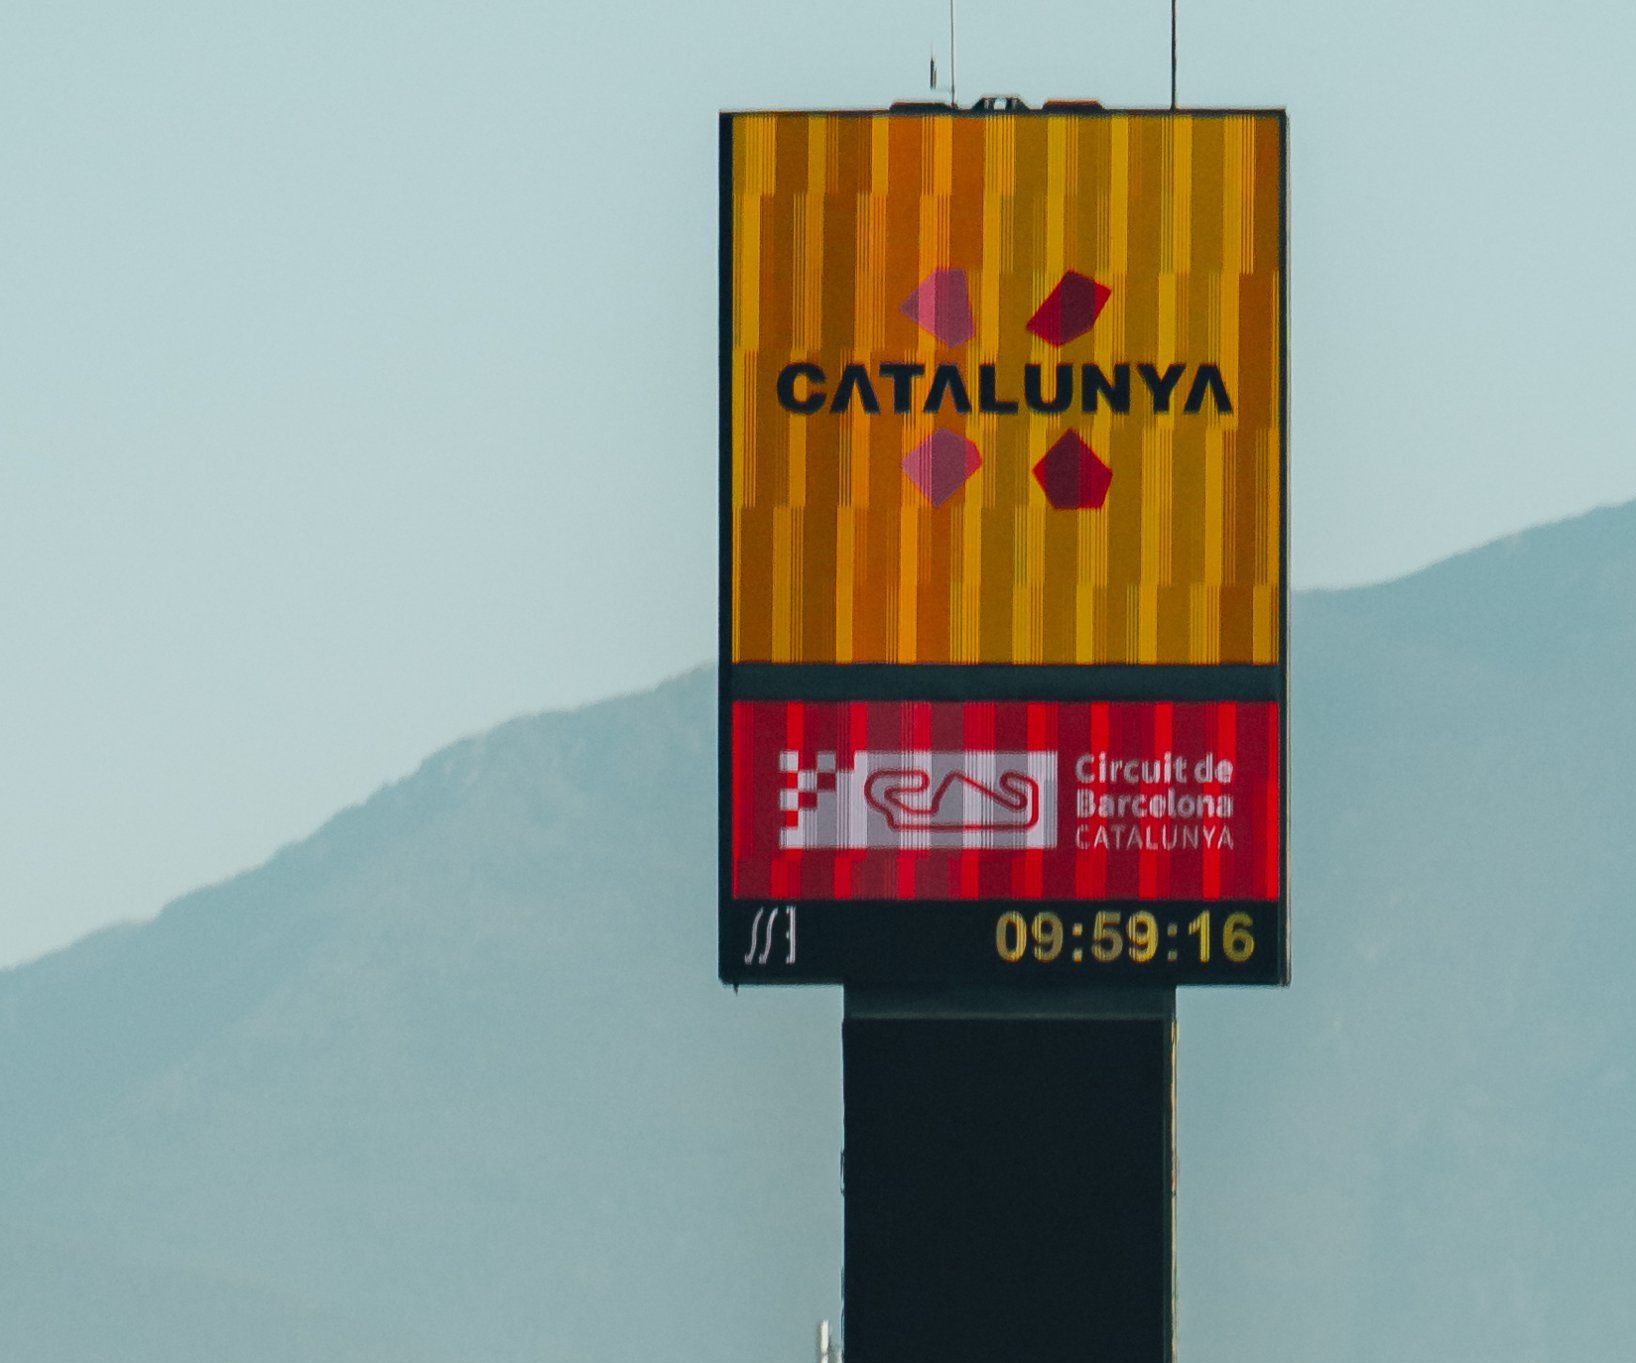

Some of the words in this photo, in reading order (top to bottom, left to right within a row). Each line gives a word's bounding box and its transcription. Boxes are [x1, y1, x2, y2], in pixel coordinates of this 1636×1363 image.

[776, 361, 1233, 415] CATALUNYA
[1075, 752, 1188, 784] Circuit
[1194, 752, 1234, 784] de
[1076, 787, 1234, 819] Barcelona
[1076, 823, 1234, 850] CATALUNYA
[996, 910, 1256, 963] 09:59:16
